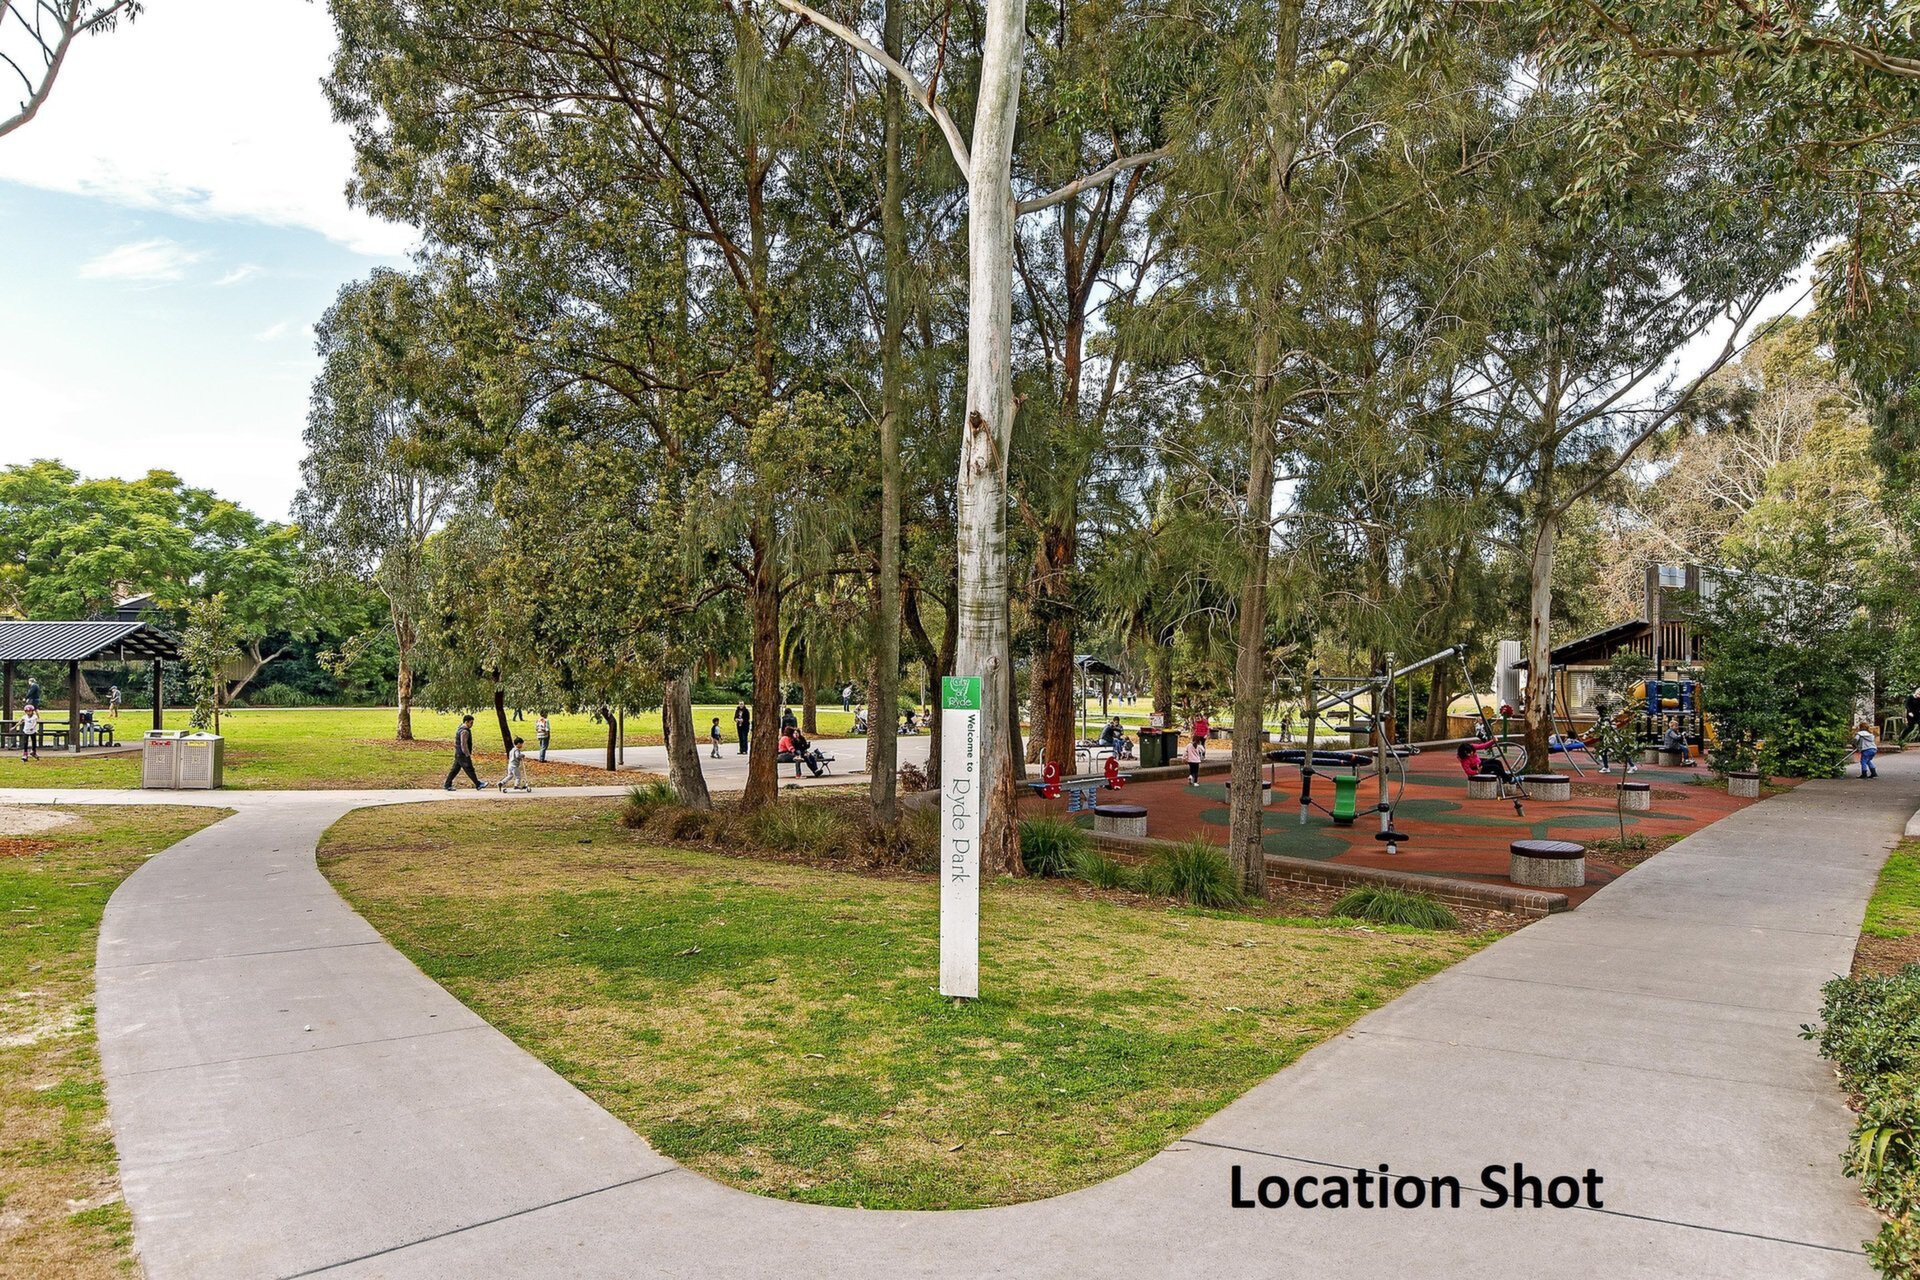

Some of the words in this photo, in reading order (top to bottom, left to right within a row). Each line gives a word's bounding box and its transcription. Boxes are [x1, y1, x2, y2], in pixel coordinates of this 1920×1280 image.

[947, 697, 972, 708] Ryde
[967, 714, 976, 758] Welcome
[966, 762, 974, 773] to
[946, 779, 971, 831] Ryde
[951, 839, 970, 882] Park
